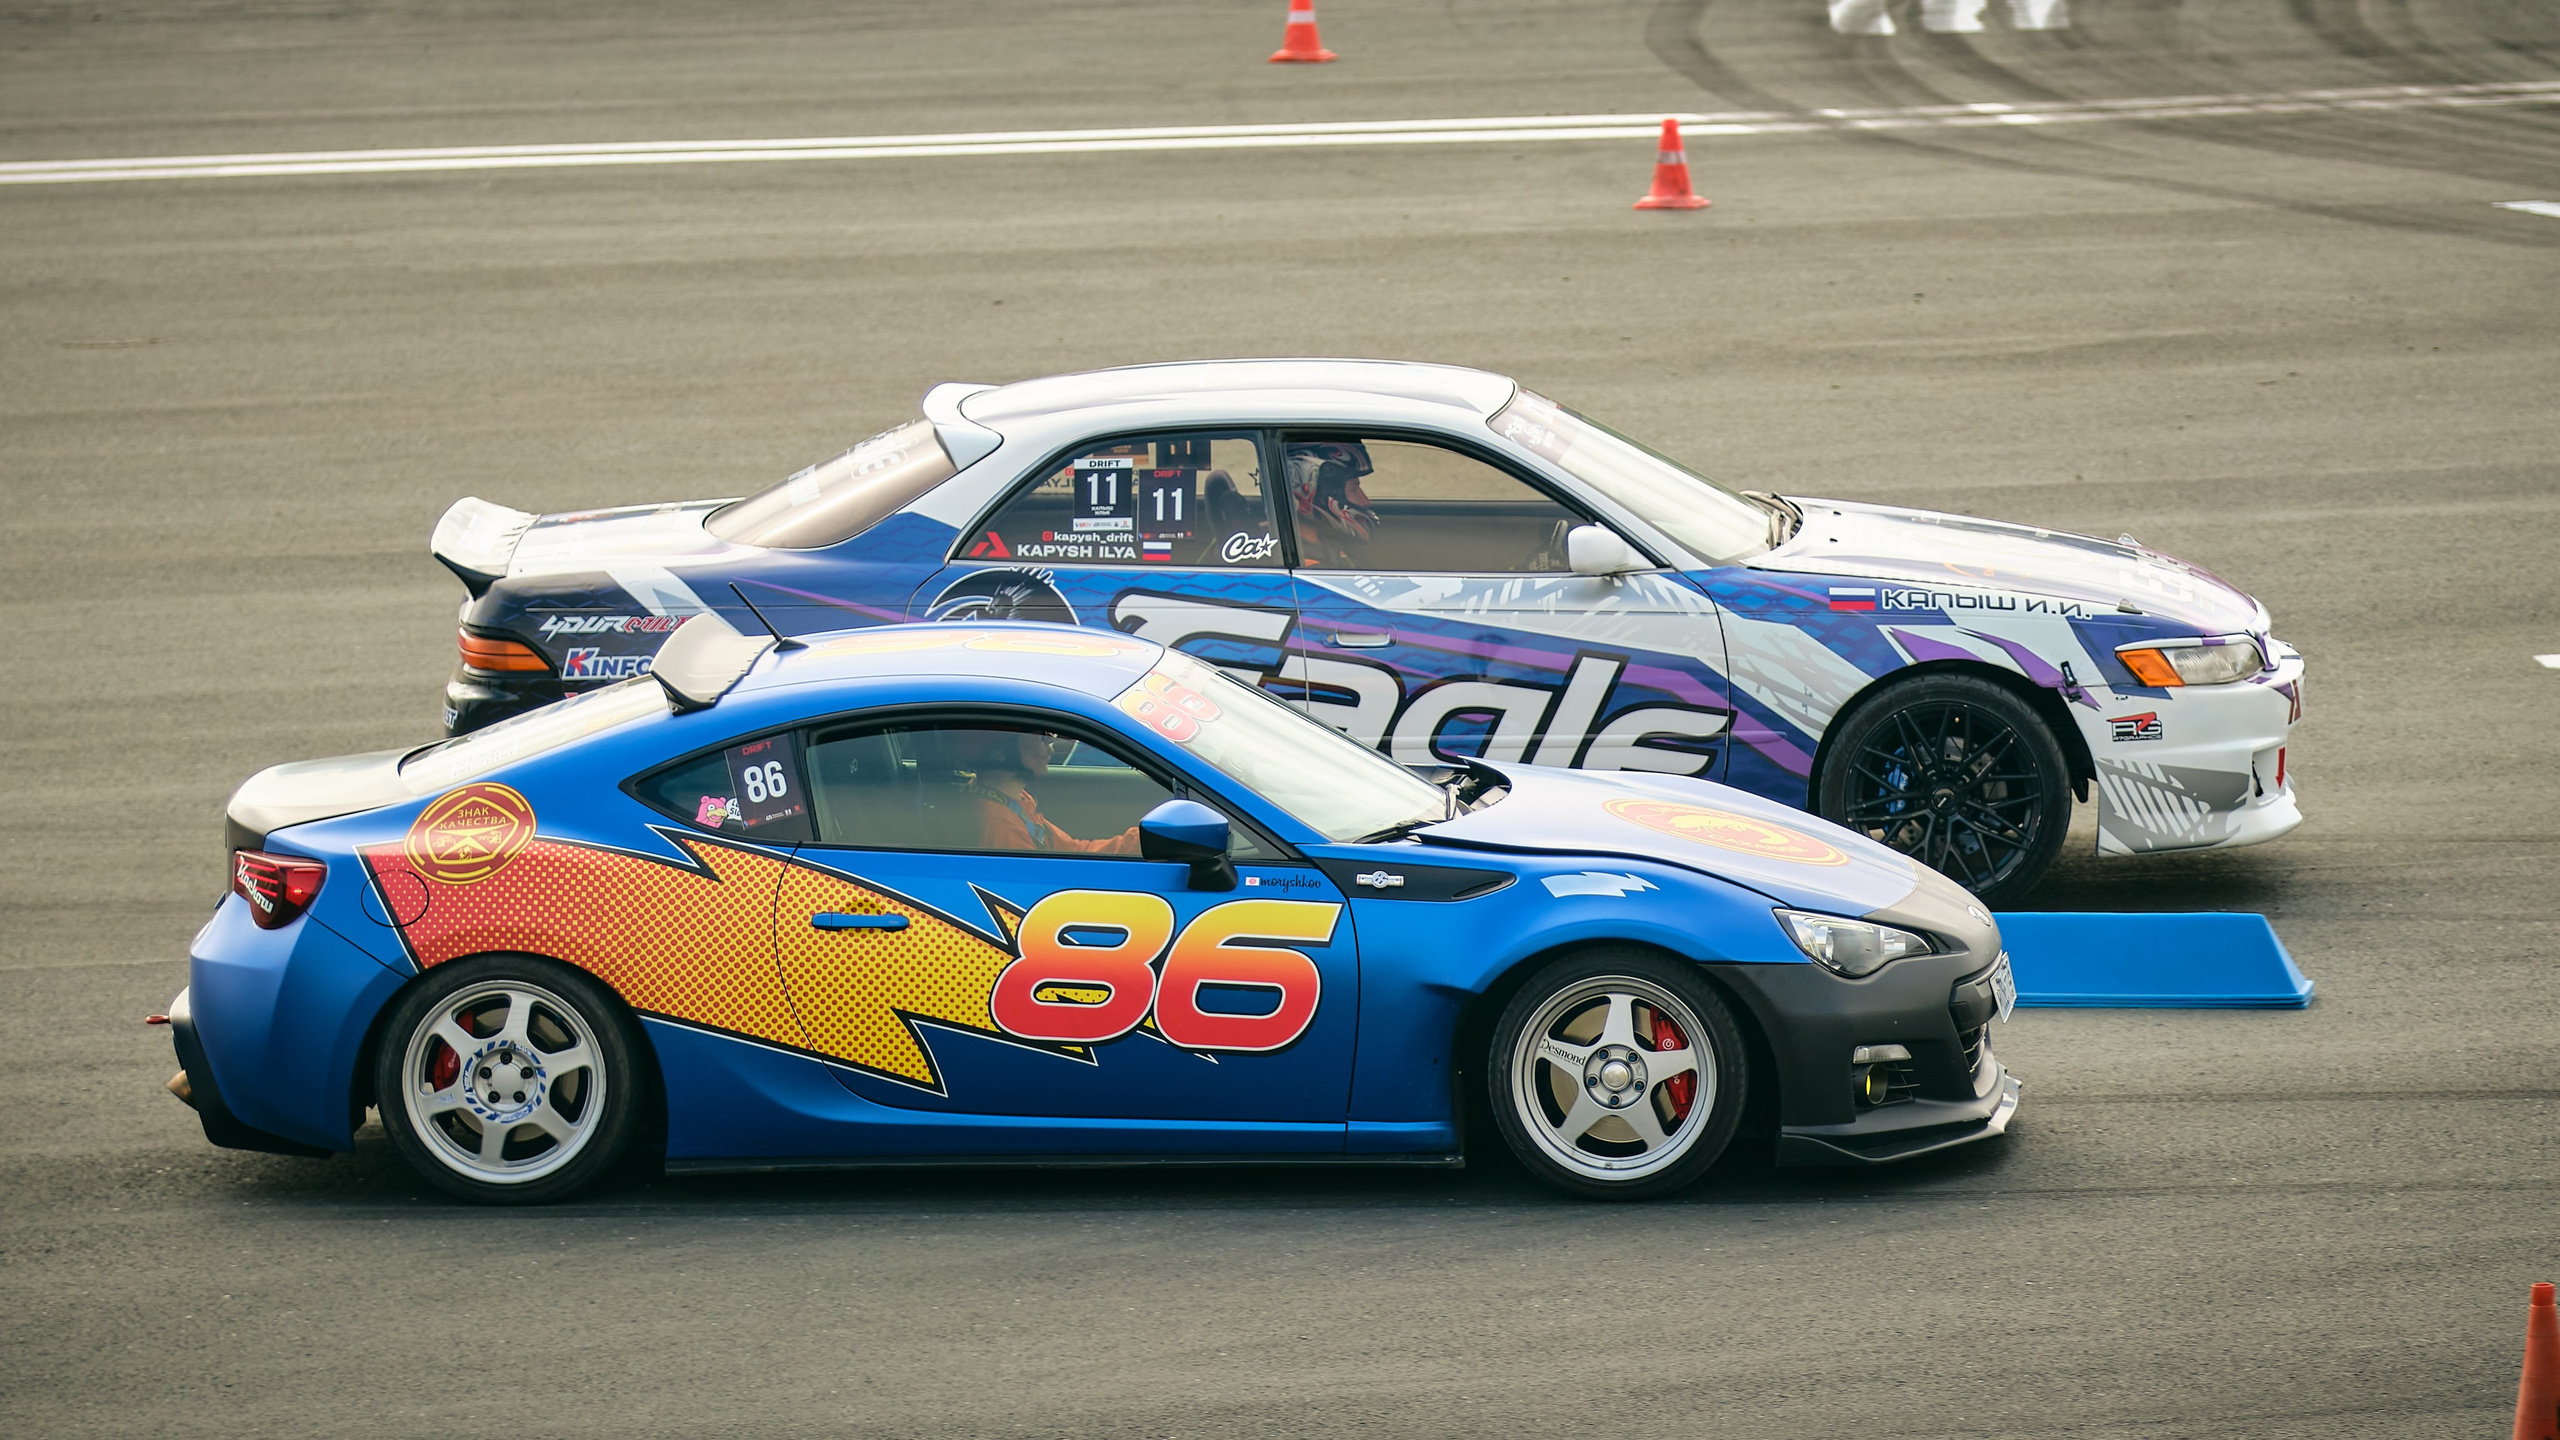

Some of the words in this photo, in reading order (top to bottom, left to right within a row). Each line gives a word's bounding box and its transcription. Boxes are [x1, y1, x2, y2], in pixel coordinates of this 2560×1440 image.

[1089, 460, 1121, 468] DRIFT
[1153, 470, 1182, 478] DRIFT
[1087, 472, 1117, 505] 11
[1152, 488, 1183, 521] 11
[1053, 531, 1134, 544] kapysh_drift
[1017, 544, 1093, 558] KAPYSH
[1099, 545, 1137, 559] ILYA
[1883, 589, 2016, 611] КАПЫШ
[1120, 671, 1224, 742] 86
[741, 740, 772, 756] DRIFT
[744, 760, 788, 804] 86
[458, 806, 490, 819] ЗНАК
[440, 816, 507, 830] КАЧЕСТВА
[1260, 874, 1321, 893] moryshkov
[991, 890, 1345, 1052] 86
[1539, 1038, 1587, 1066] Desmond
